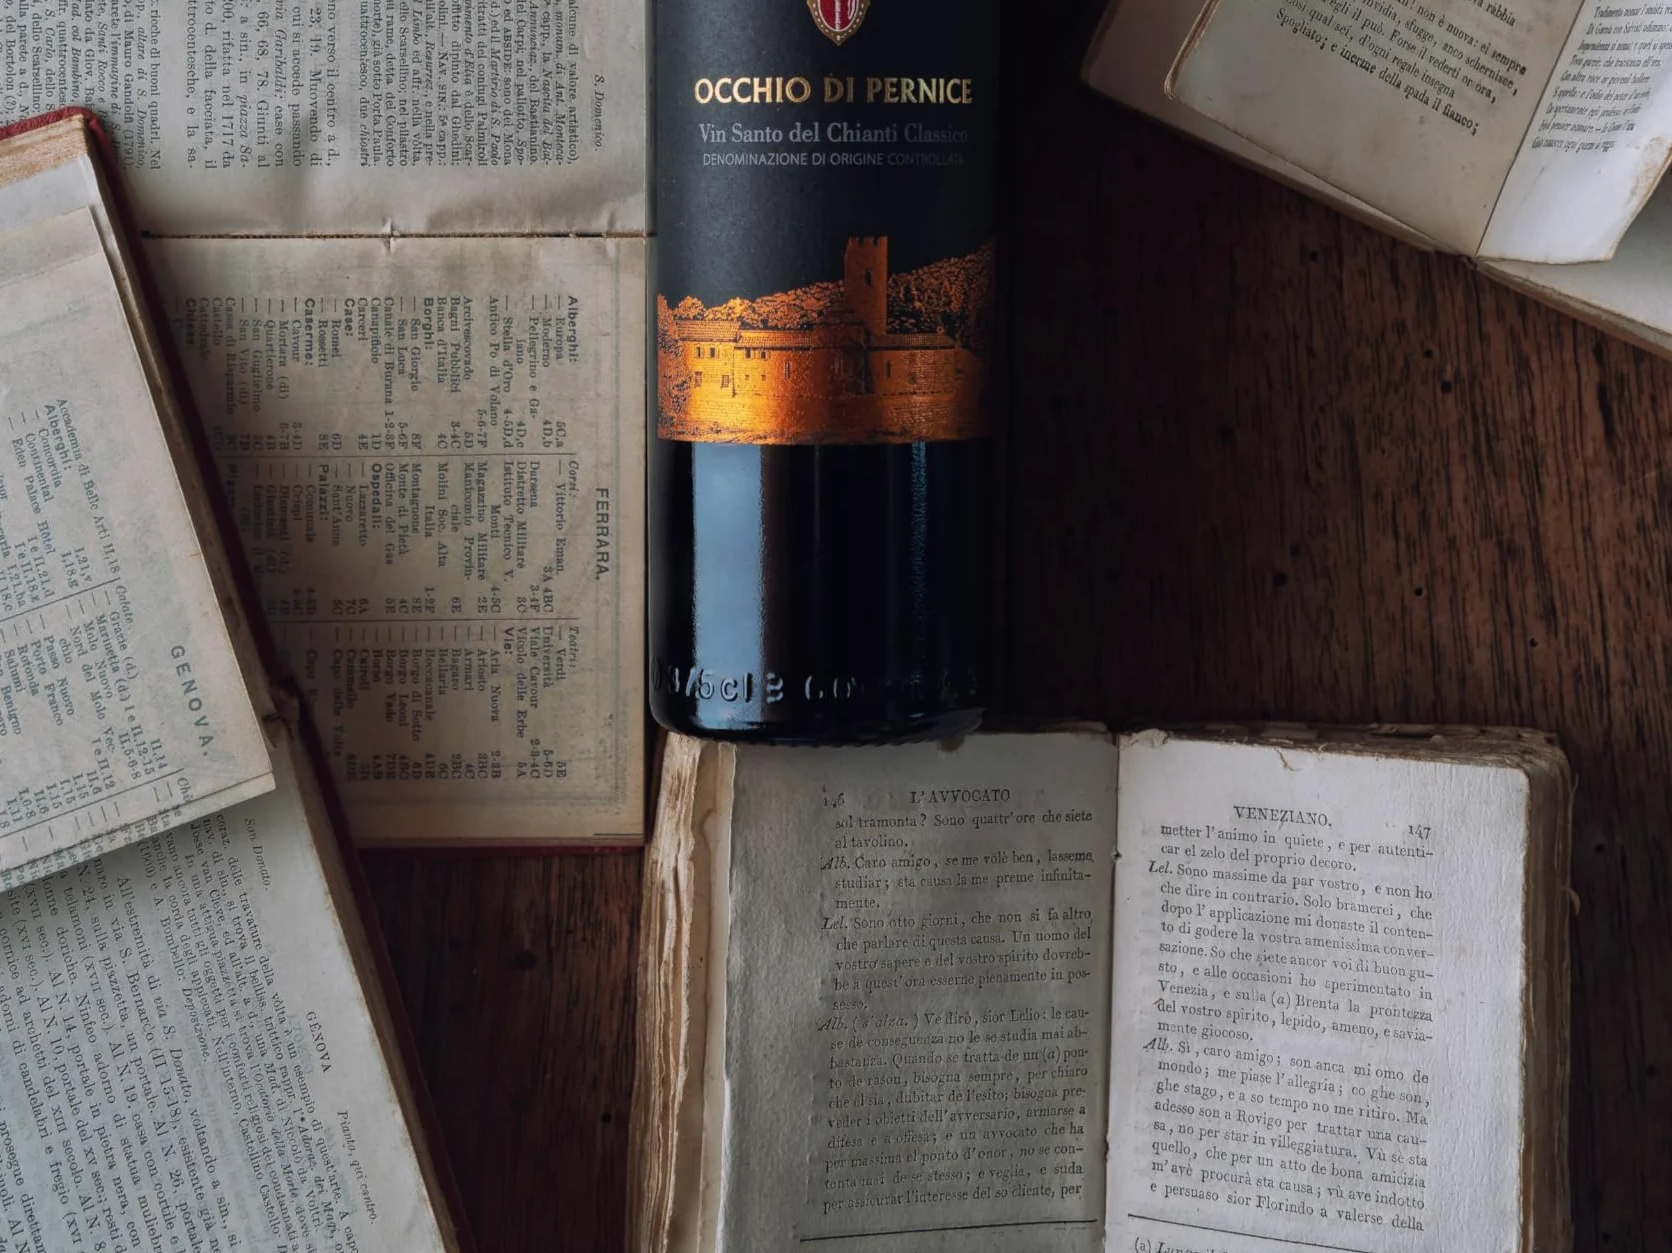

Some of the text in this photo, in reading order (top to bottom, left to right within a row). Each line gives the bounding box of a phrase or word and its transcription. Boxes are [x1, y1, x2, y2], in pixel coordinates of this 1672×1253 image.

[695, 77, 972, 104] OCCHIO DI PERNICE
[699, 122, 967, 143] Vin Santo del Chianti Classico
[703, 152, 807, 166] DENOMINAZIONE
[812, 153, 826, 165] DI
[830, 152, 883, 166] ORIGINE
[421, 297, 435, 350] Borghi:
[542, 317, 553, 368] Moderno
[553, 317, 566, 360] Europa
[566, 295, 579, 362] Alberghi:
[38, 428, 62, 488] Concordia
[44, 405, 73, 470] Alberghi:
[25, 433, 54, 503] Continental
[56, 399, 82, 461] Accademia
[78, 464, 90, 477] di
[93, 516, 110, 540] Arti
[595, 488, 610, 580] FERRARA.
[171, 645, 214, 756] GENOVA.
[835, 834, 908, 849] al tavolino.
[1233, 805, 1332, 829] VENEZIANO.
[1408, 824, 1431, 840] 147
[1149, 860, 1432, 900] Lel. Sono massime da par vostro, e non ho
